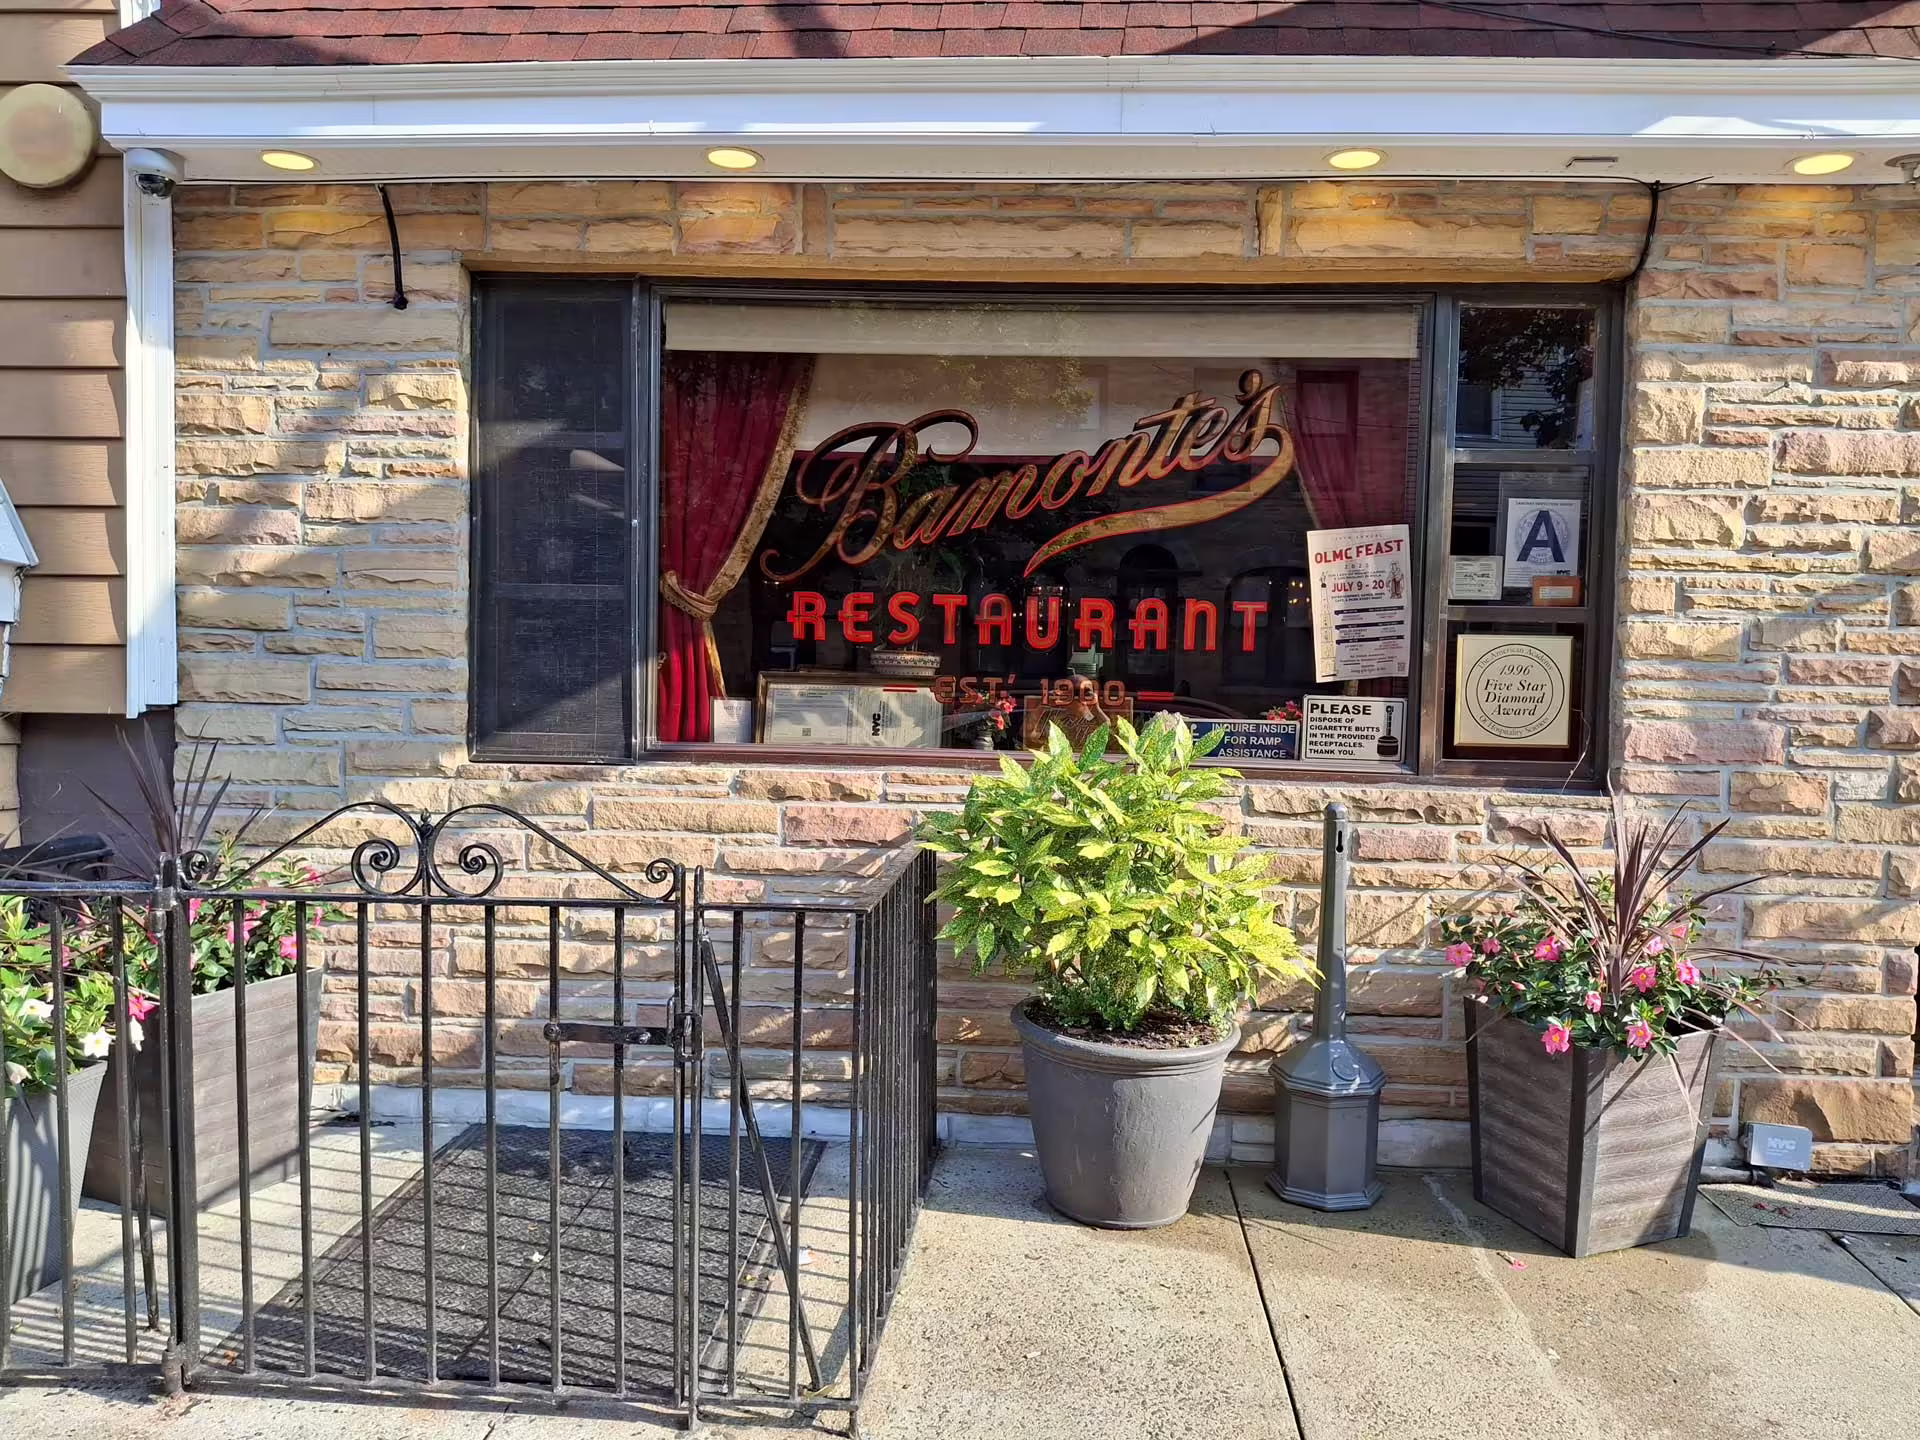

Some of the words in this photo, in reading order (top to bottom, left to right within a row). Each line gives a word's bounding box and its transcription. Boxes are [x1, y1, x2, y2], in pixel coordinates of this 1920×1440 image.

[759, 369, 1294, 583] Bamonte's
[1516, 510, 1565, 563] A
[1315, 547, 1353, 564] OLMC
[1356, 539, 1404, 557] FEAST
[1332, 581, 1354, 592] JULY
[1357, 581, 1363, 591] 9
[1372, 579, 1385, 590] 20
[787, 591, 1269, 651] RESTAURANT
[1478, 656, 1489, 669] The
[1491, 647, 1525, 659] American
[1527, 648, 1554, 671] Academy
[1500, 664, 1534, 676] 1996
[1484, 678, 1513, 691] Five
[1517, 679, 1547, 692] Star
[1040, 678, 1126, 706] 1900
[1485, 691, 1545, 704] Diamond
[1310, 703, 1372, 716] PLEASE
[1491, 704, 1538, 716] Award
[872, 713, 881, 736] NYC
[1212, 723, 1257, 733] INQUIRE
[1260, 724, 1296, 734] INSIDE
[1309, 724, 1353, 732] CIGARETTE
[1487, 722, 1524, 737] Hospitality
[1224, 736, 1247, 745] FOR
[1250, 736, 1282, 746] RAMP
[1309, 740, 1364, 748] RECEPTACLES.
[1217, 748, 1287, 758] ASSISTANCE
